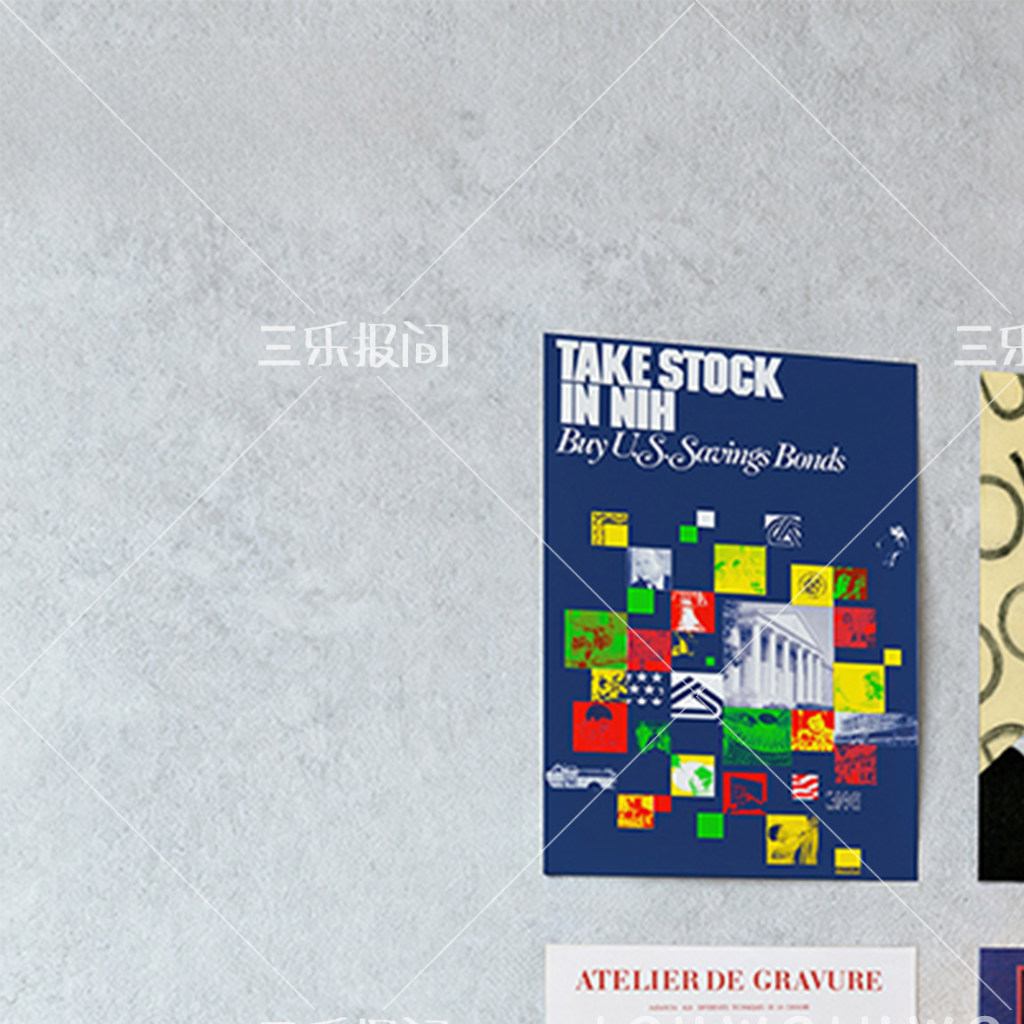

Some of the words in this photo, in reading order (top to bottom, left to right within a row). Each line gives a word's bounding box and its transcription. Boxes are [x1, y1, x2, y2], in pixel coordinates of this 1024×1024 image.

[556, 339, 652, 388] TAKE
[659, 348, 784, 399] STOCK
[560, 382, 600, 426] IN
[610, 386, 676, 432] NIH
[556, 428, 608, 465] Buy
[613, 431, 670, 469] U.S.
[669, 435, 771, 477] Savings
[773, 442, 847, 473] Bonds
[575, 969, 699, 992] ATELIER
[707, 969, 744, 992] DE
[752, 969, 883, 992] GRAVURE
